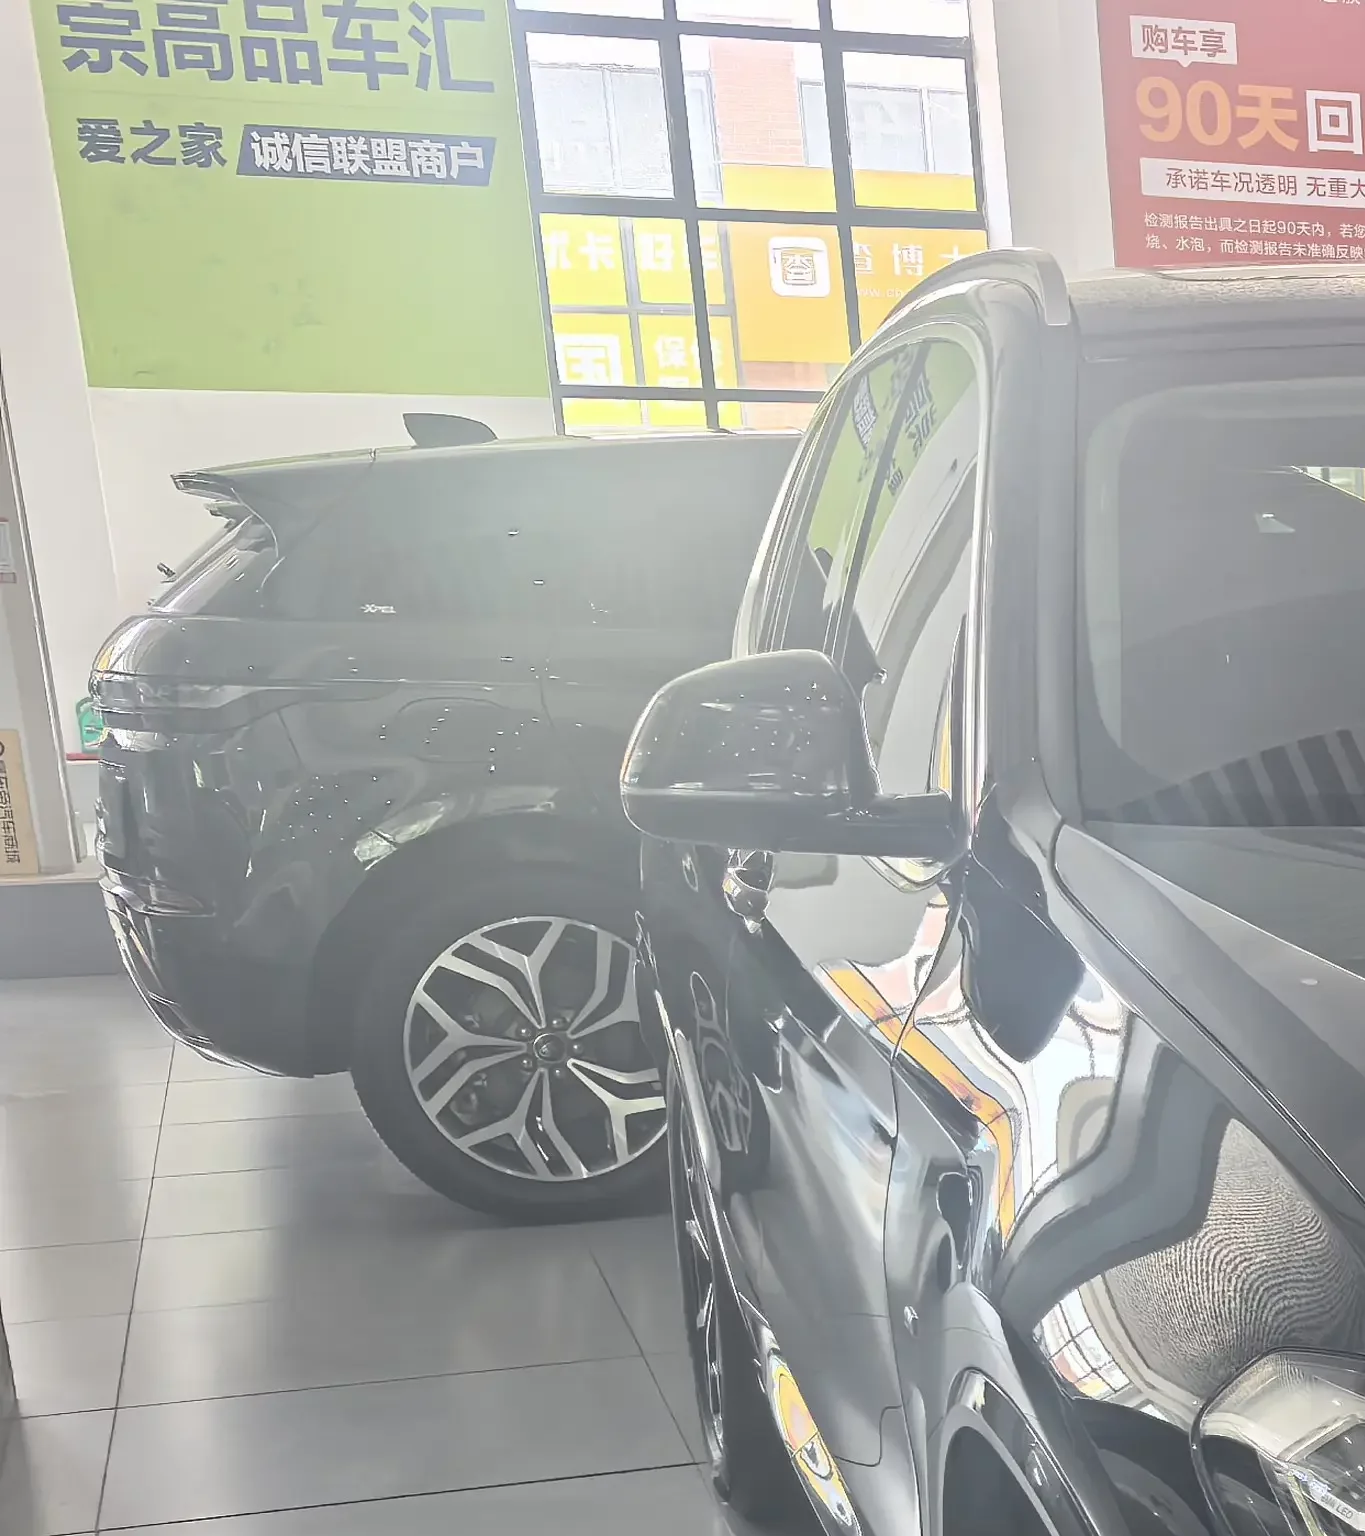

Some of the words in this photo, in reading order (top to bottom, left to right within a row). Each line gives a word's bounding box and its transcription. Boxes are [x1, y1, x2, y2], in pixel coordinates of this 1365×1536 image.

[1141, 24, 1228, 59] 购车享
[76, 118, 228, 168] 爱之家
[250, 131, 485, 181] 诚信联盟商户
[1165, 167, 1298, 198] 承诺车况透明
